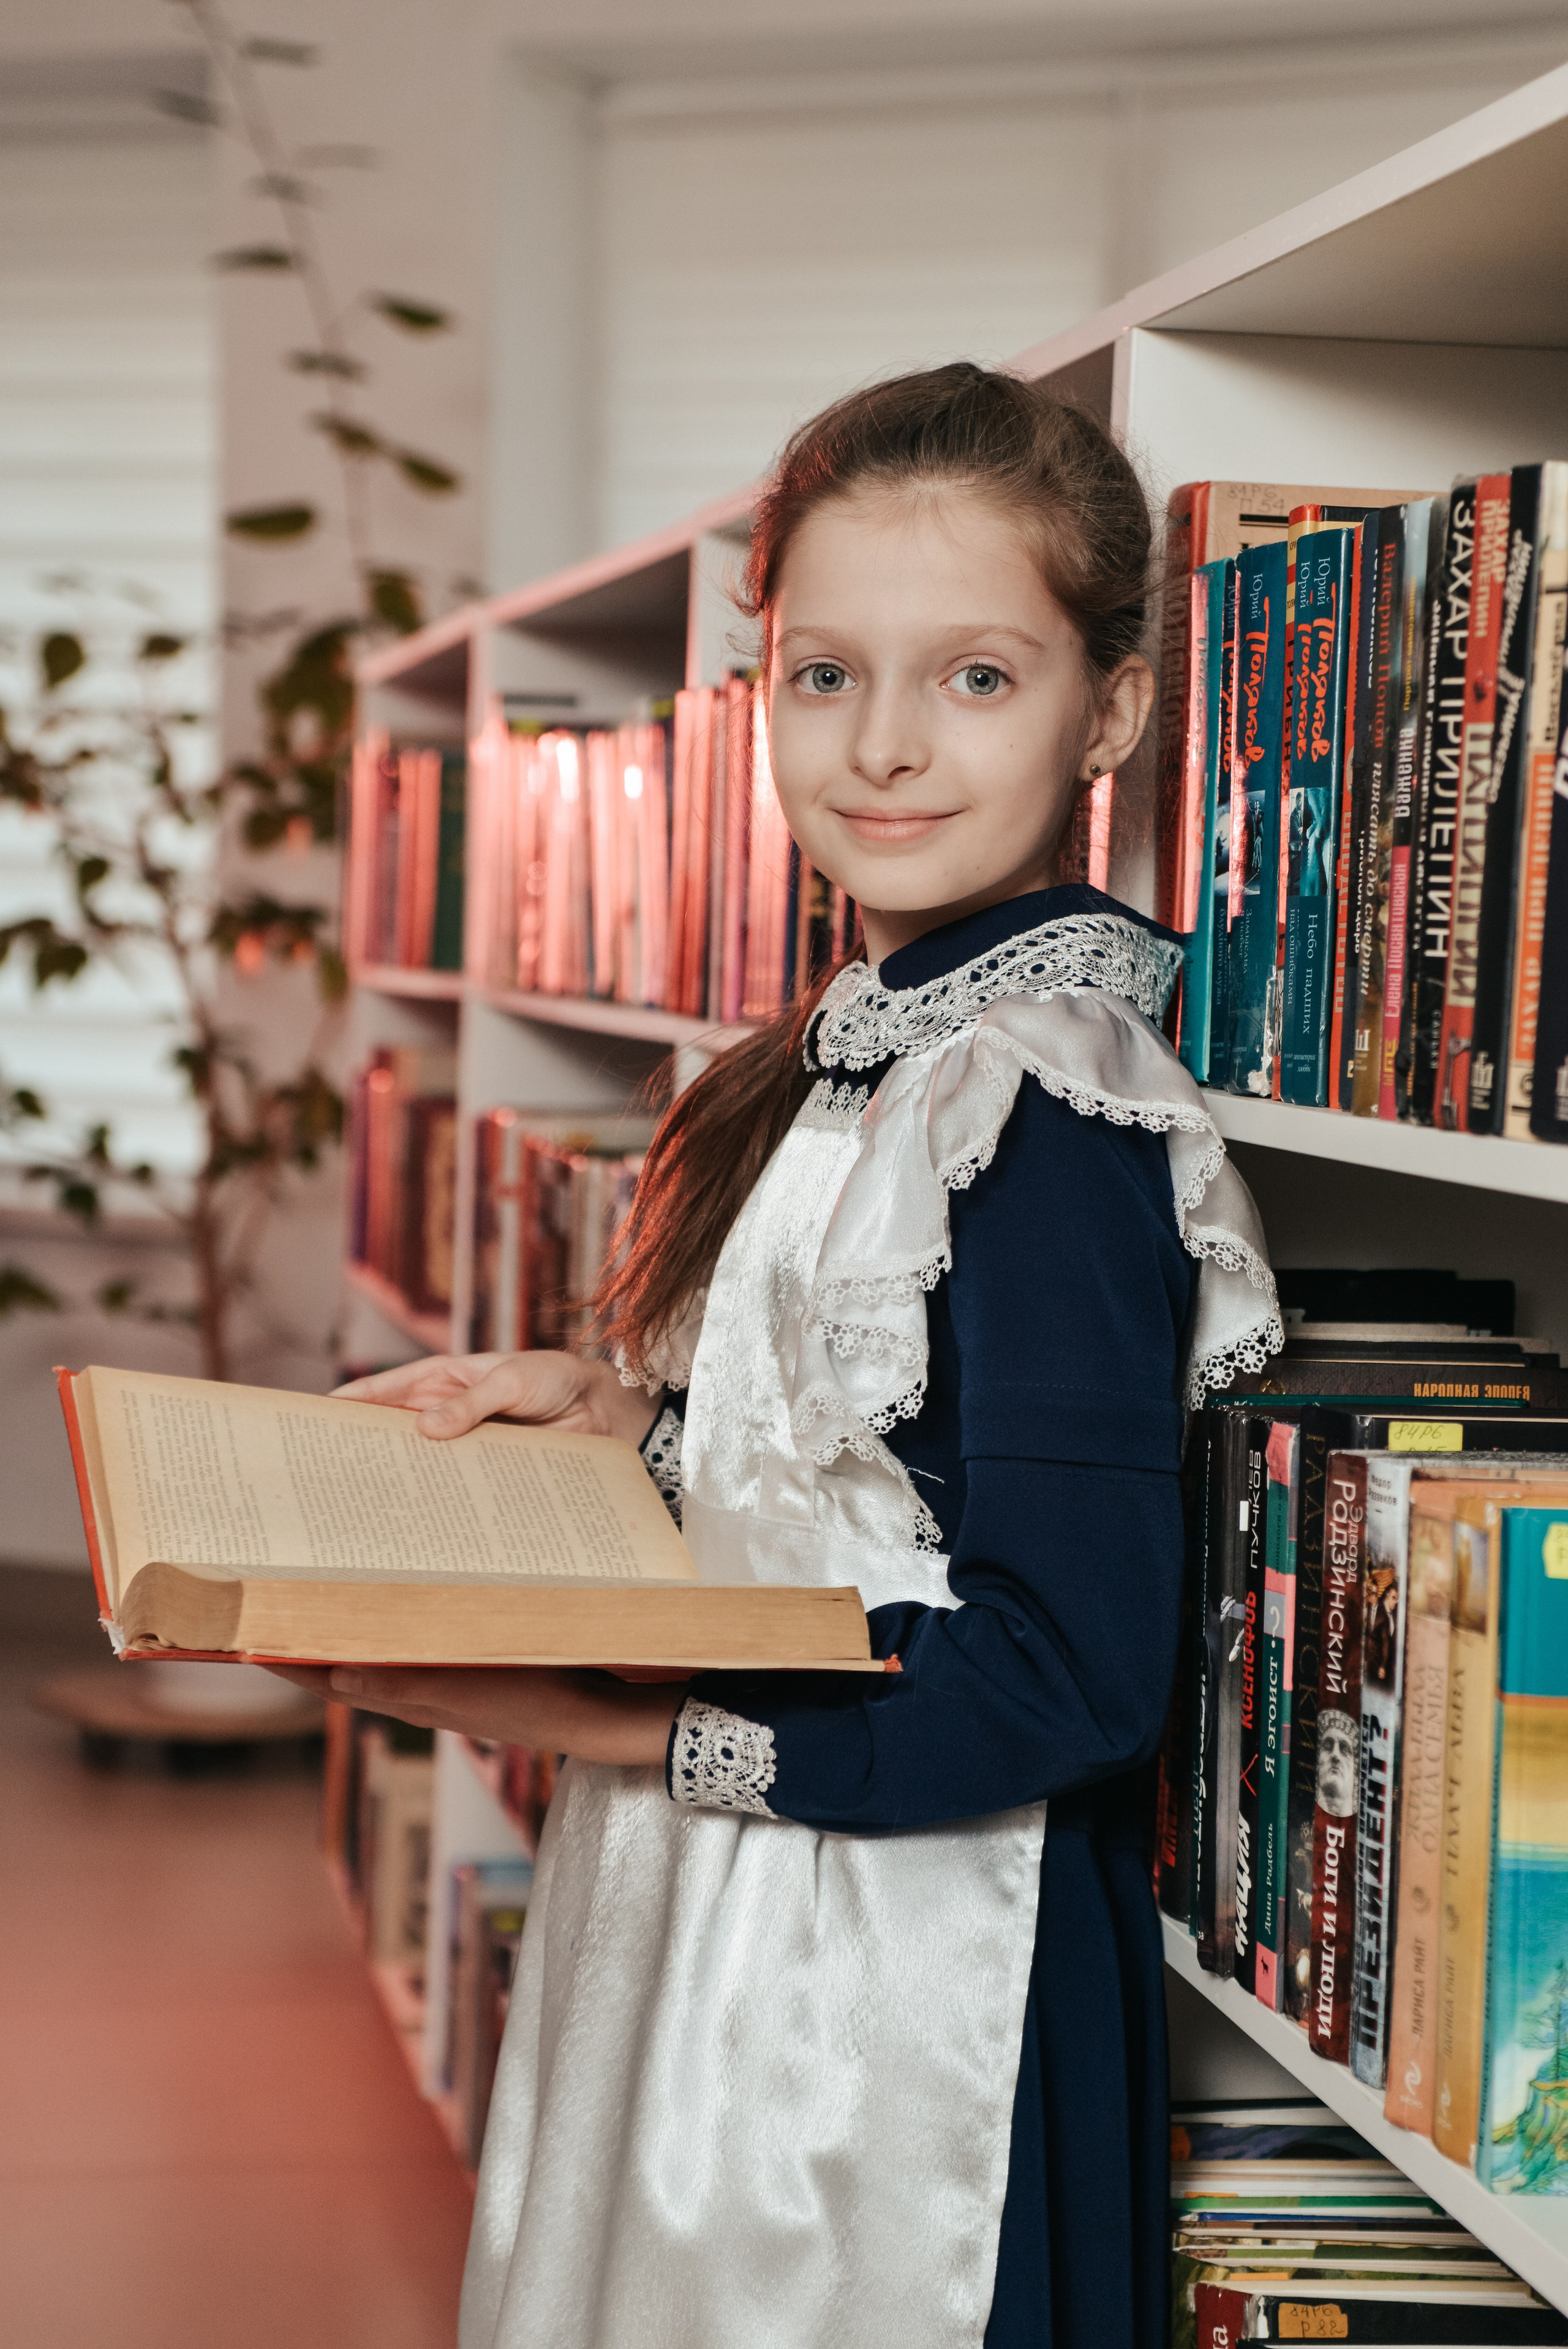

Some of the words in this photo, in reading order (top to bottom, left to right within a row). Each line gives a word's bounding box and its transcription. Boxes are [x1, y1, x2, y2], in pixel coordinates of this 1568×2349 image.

[1317, 557, 1331, 606] Юрий
[1444, 500, 1475, 660] ЗАХАР
[1475, 500, 1498, 637] ПРИЛЕПИН
[1490, 499, 1510, 583] ЗАХАР
[1251, 573, 1264, 620] Юрий
[1300, 560, 1311, 608] Юрий
[1376, 542, 1397, 655] Валерий
[1244, 596, 1270, 763] Поляков
[1297, 622, 1311, 760] Поляков
[1311, 582, 1336, 763] Поляков
[1373, 664, 1391, 748] Попов
[1367, 762, 1383, 862] плясать
[1395, 727, 1414, 818] Важенка
[1425, 677, 1465, 957] ПРИЛЕПИН
[1366, 869, 1379, 897] до
[1387, 864, 1408, 969] Посвятовская
[1216, 909, 1226, 967] блудного
[1243, 908, 1253, 975] Замыслил
[1287, 935, 1297, 1005] ошибками
[1306, 913, 1318, 959] Небо
[1360, 903, 1375, 996] смерти
[1215, 969, 1224, 1005] мужа
[1302, 968, 1314, 1034] падших
[1384, 974, 1402, 1018] Елена
[1414, 1382, 1479, 1399] НАРОДНАЯ
[1484, 1385, 1531, 1401] ЭПОПЕЯ
[1250, 1450, 1262, 1569] ПУЧКОВ
[1346, 1507, 1363, 1583] Эдвард
[1326, 1479, 1357, 1695] Радзинский
[1267, 1656, 1279, 1750] эгоист
[1264, 1757, 1276, 1778] Я
[1235, 1809, 1251, 1957] НАЦИЯ
[1265, 1822, 1274, 1887] Радбель
[1323, 1825, 1345, 1906] Боги
[1356, 1714, 1389, 2051] ПРЕЗИДЕНТ?
[1264, 1893, 1273, 1935] Дина
[1322, 1912, 1339, 1937] и
[1315, 1940, 1336, 2039] люди
[1412, 1936, 1427, 1975] РАЙТ
[1411, 1980, 1426, 2038] ЛАРИСА
